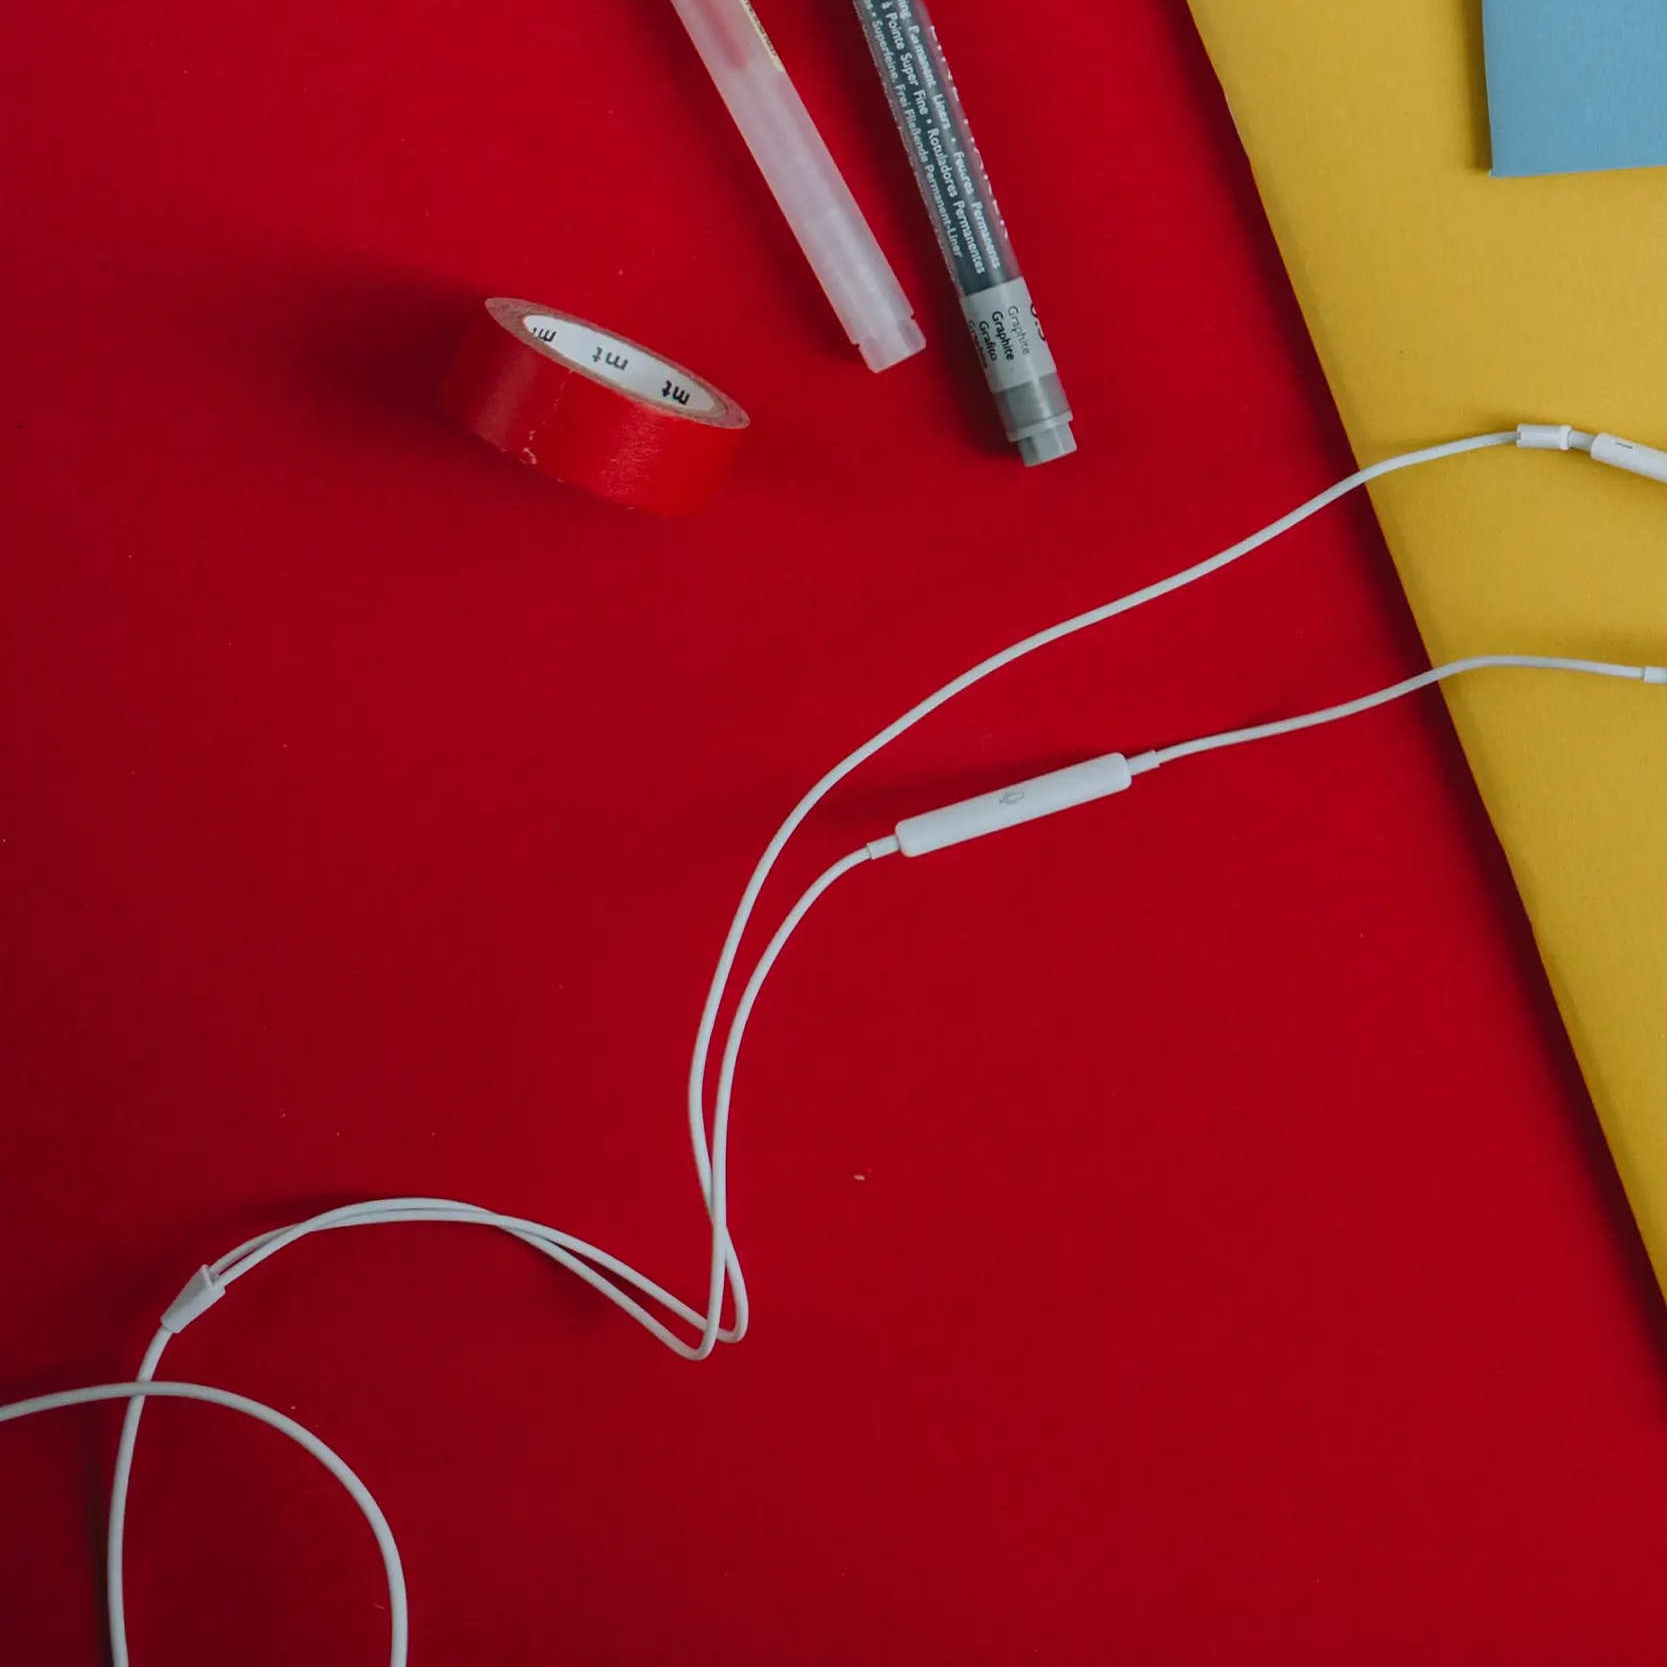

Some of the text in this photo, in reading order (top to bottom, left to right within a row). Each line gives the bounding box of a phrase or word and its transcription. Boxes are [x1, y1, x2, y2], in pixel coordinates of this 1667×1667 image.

[881, 1, 893, 10] à
[885, 12, 905, 50] Pointe
[900, 52, 919, 86] Super
[913, 89, 929, 115] Fine
[895, 83, 911, 107] Frei
[904, 108, 929, 163] Fließende
[925, 164, 963, 258] Permanent-Liner
[927, 128, 958, 198] Rotuladores
[932, 93, 952, 130] Liners
[970, 201, 1001, 270] Permanents
[952, 200, 985, 274] Permanentes
[978, 320, 998, 362] Grafito
[991, 310, 1015, 361] Graphite
[1007, 305, 1030, 355] Graphite
[592, 346, 629, 371] mt
[661, 380, 691, 406] mt
